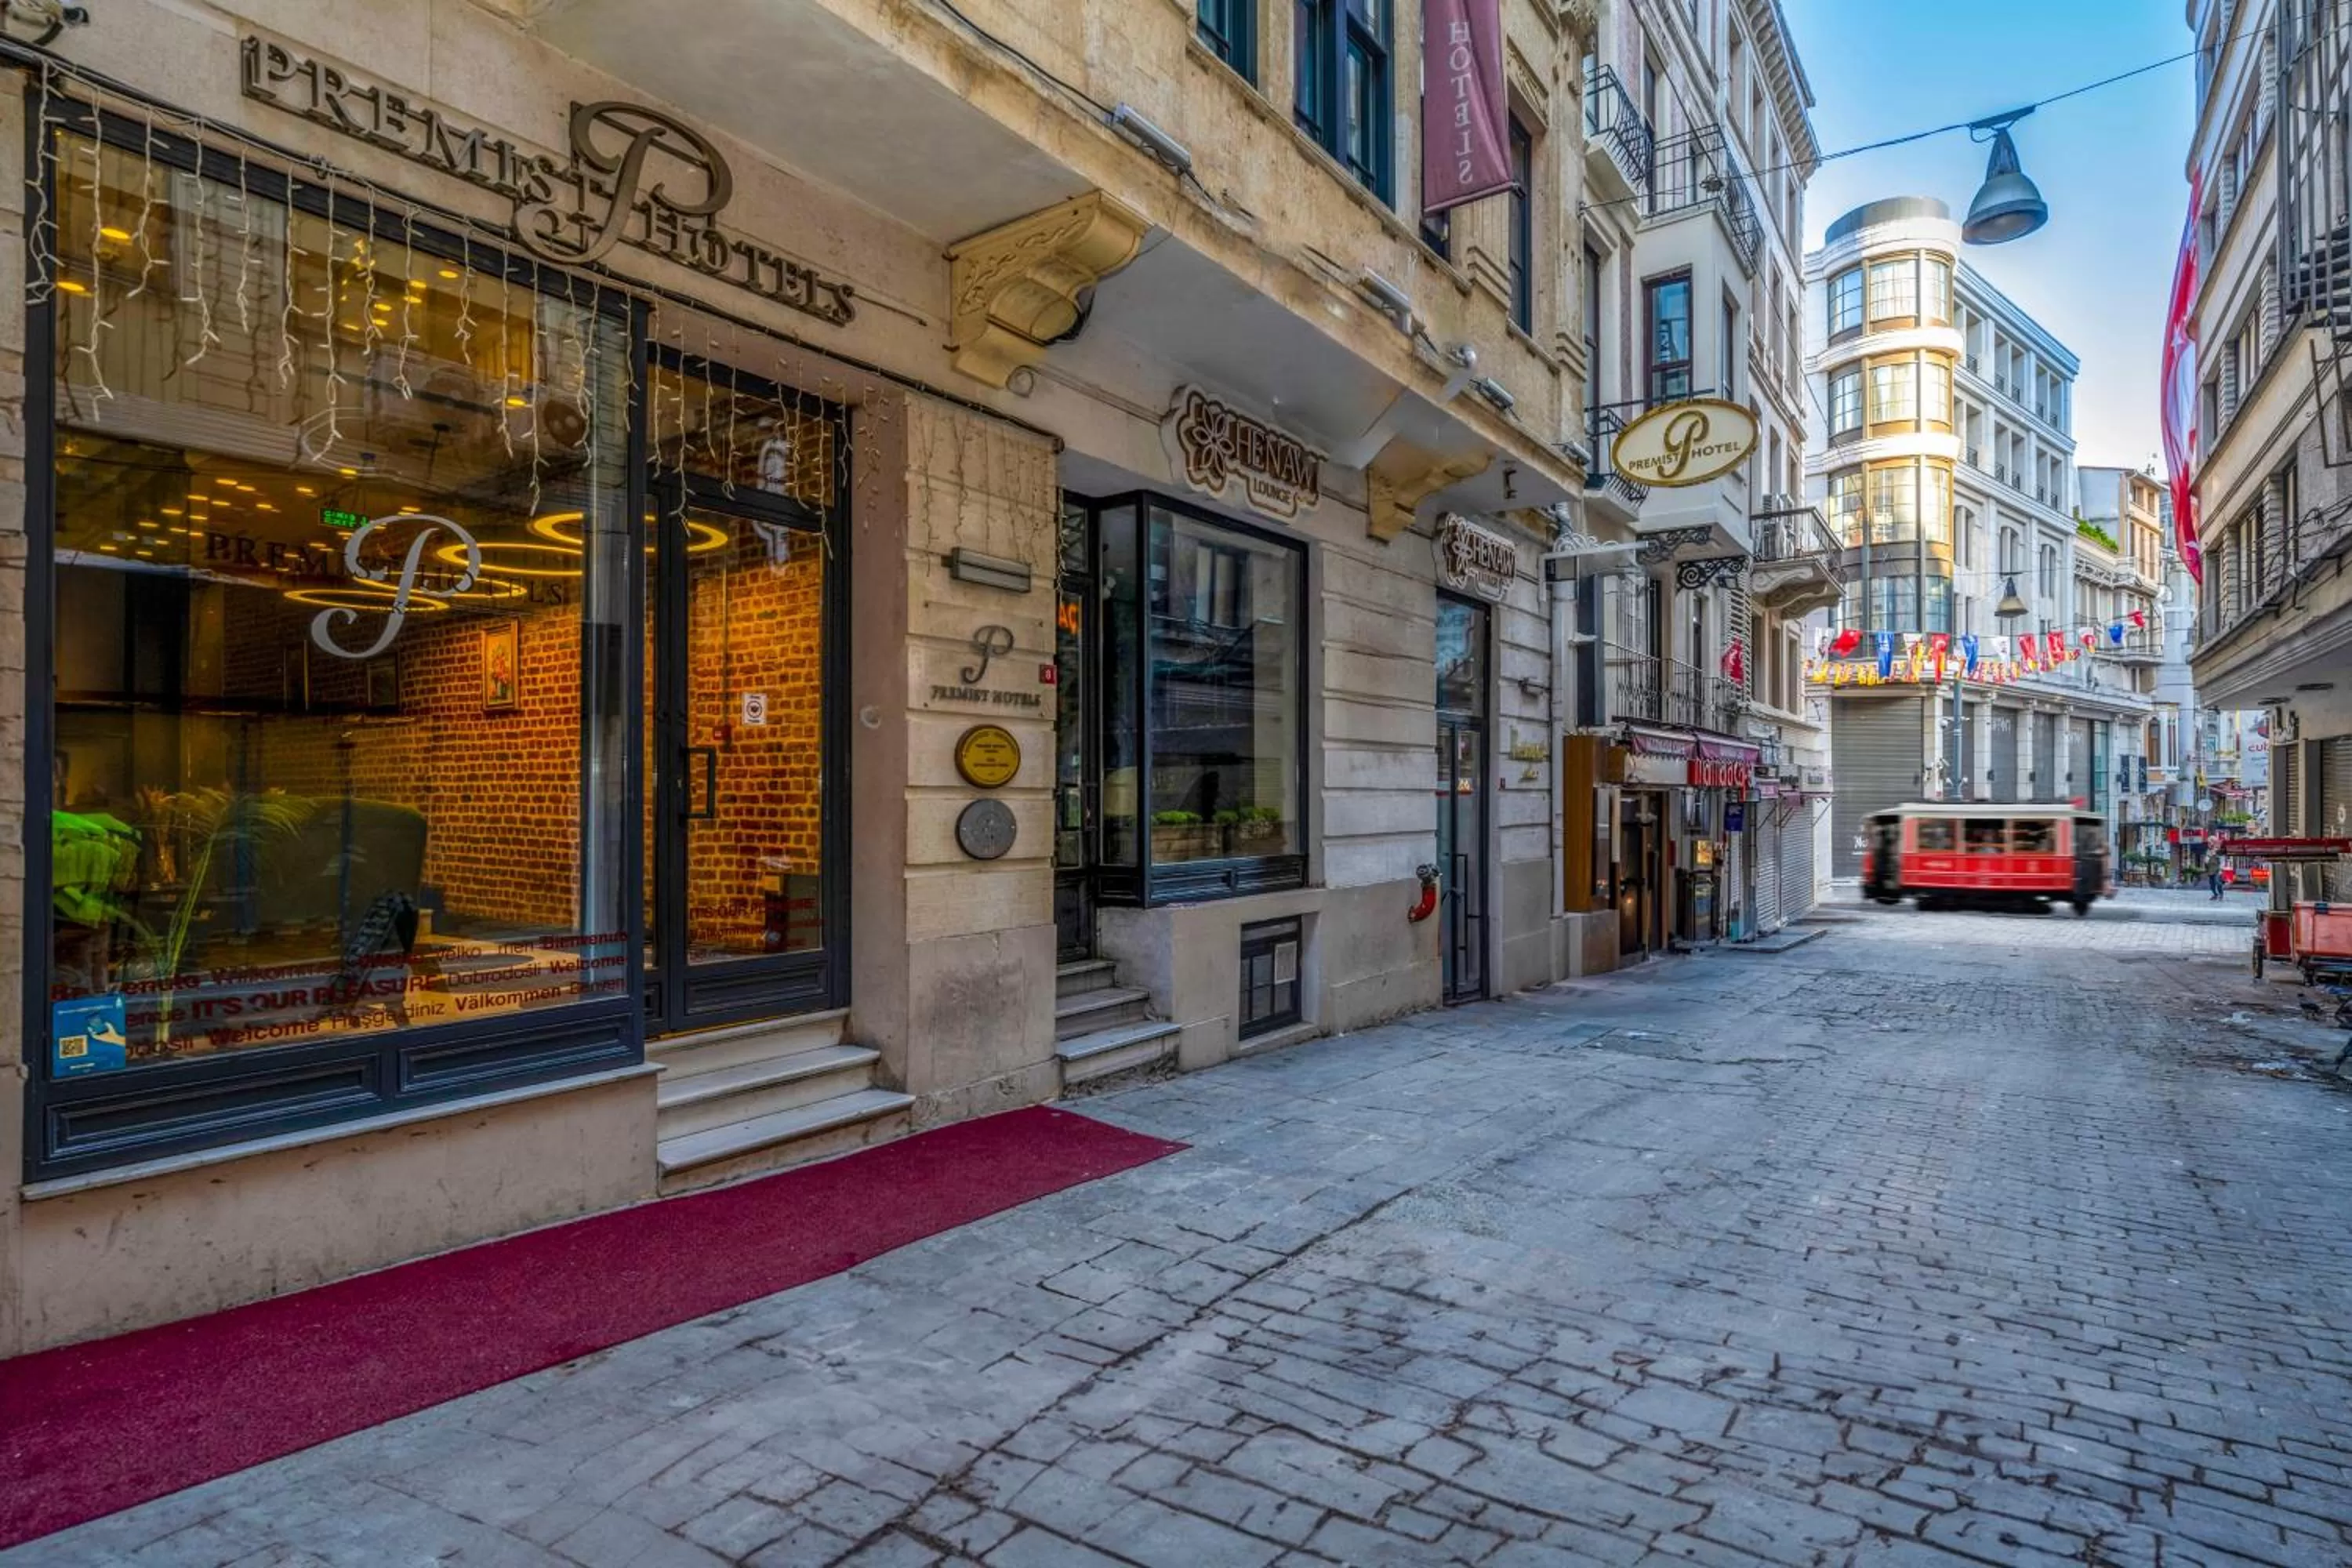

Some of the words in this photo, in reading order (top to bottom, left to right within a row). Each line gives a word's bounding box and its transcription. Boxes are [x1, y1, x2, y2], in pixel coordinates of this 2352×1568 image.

[241, 35, 605, 232] PREMIST
[637, 198, 857, 327] HOTELS
[1235, 419, 1318, 489] HENAW
[1628, 452, 1679, 470] PREMIST
[1691, 441, 1741, 459] HOTEL
[1254, 477, 1291, 505] LOUNGE
[931, 685, 990, 702] PREMIST
[992, 690, 1041, 707] HOTELS
[248, 988, 309, 1011] OUR
[209, 1018, 320, 1047] Welcome
[455, 985, 561, 1012] Välkommen
